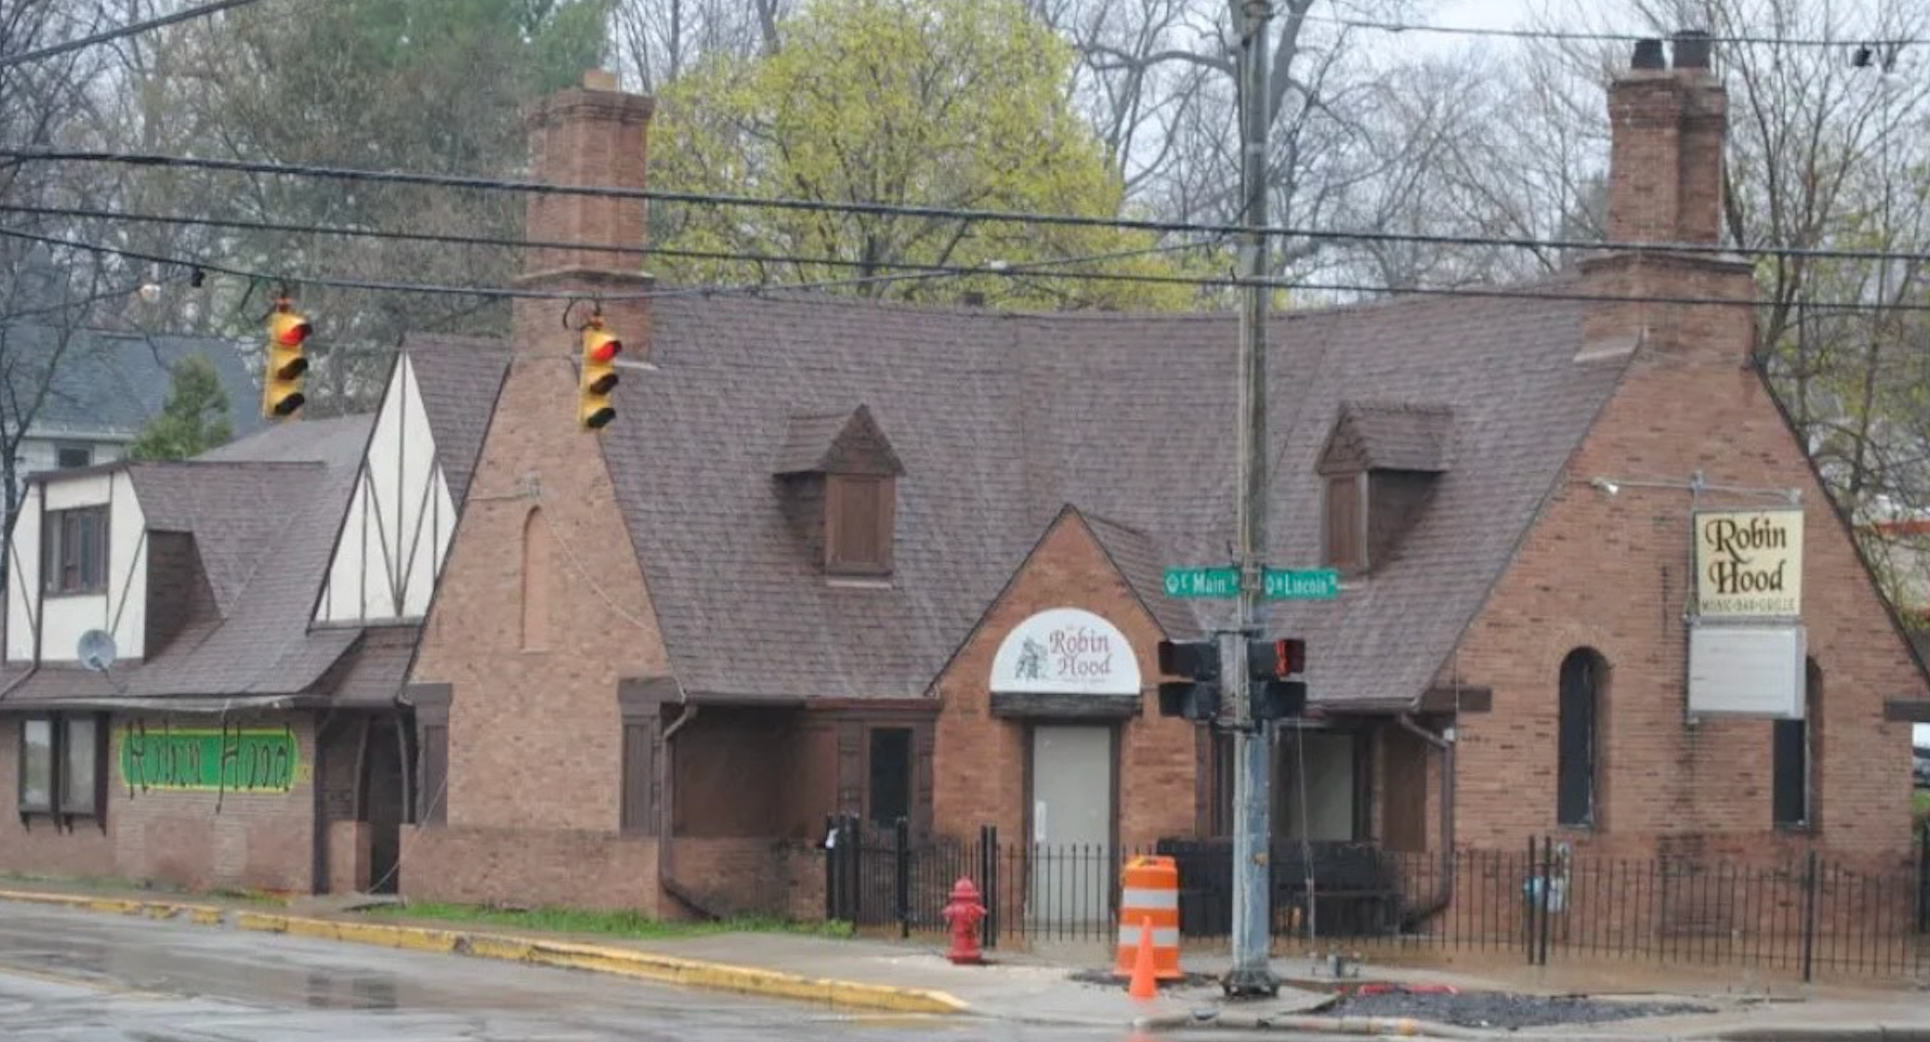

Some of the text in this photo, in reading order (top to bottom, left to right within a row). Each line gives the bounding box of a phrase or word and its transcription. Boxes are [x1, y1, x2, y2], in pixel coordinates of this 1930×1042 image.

[1705, 517, 1786, 564] Robin
[1193, 572, 1226, 593] Main
[1285, 573, 1328, 594] Lincoln
[1708, 559, 1786, 594] Hood
[1050, 626, 1110, 658] Robin
[1058, 652, 1113, 676] Hood
[215, 719, 290, 815] Hood
